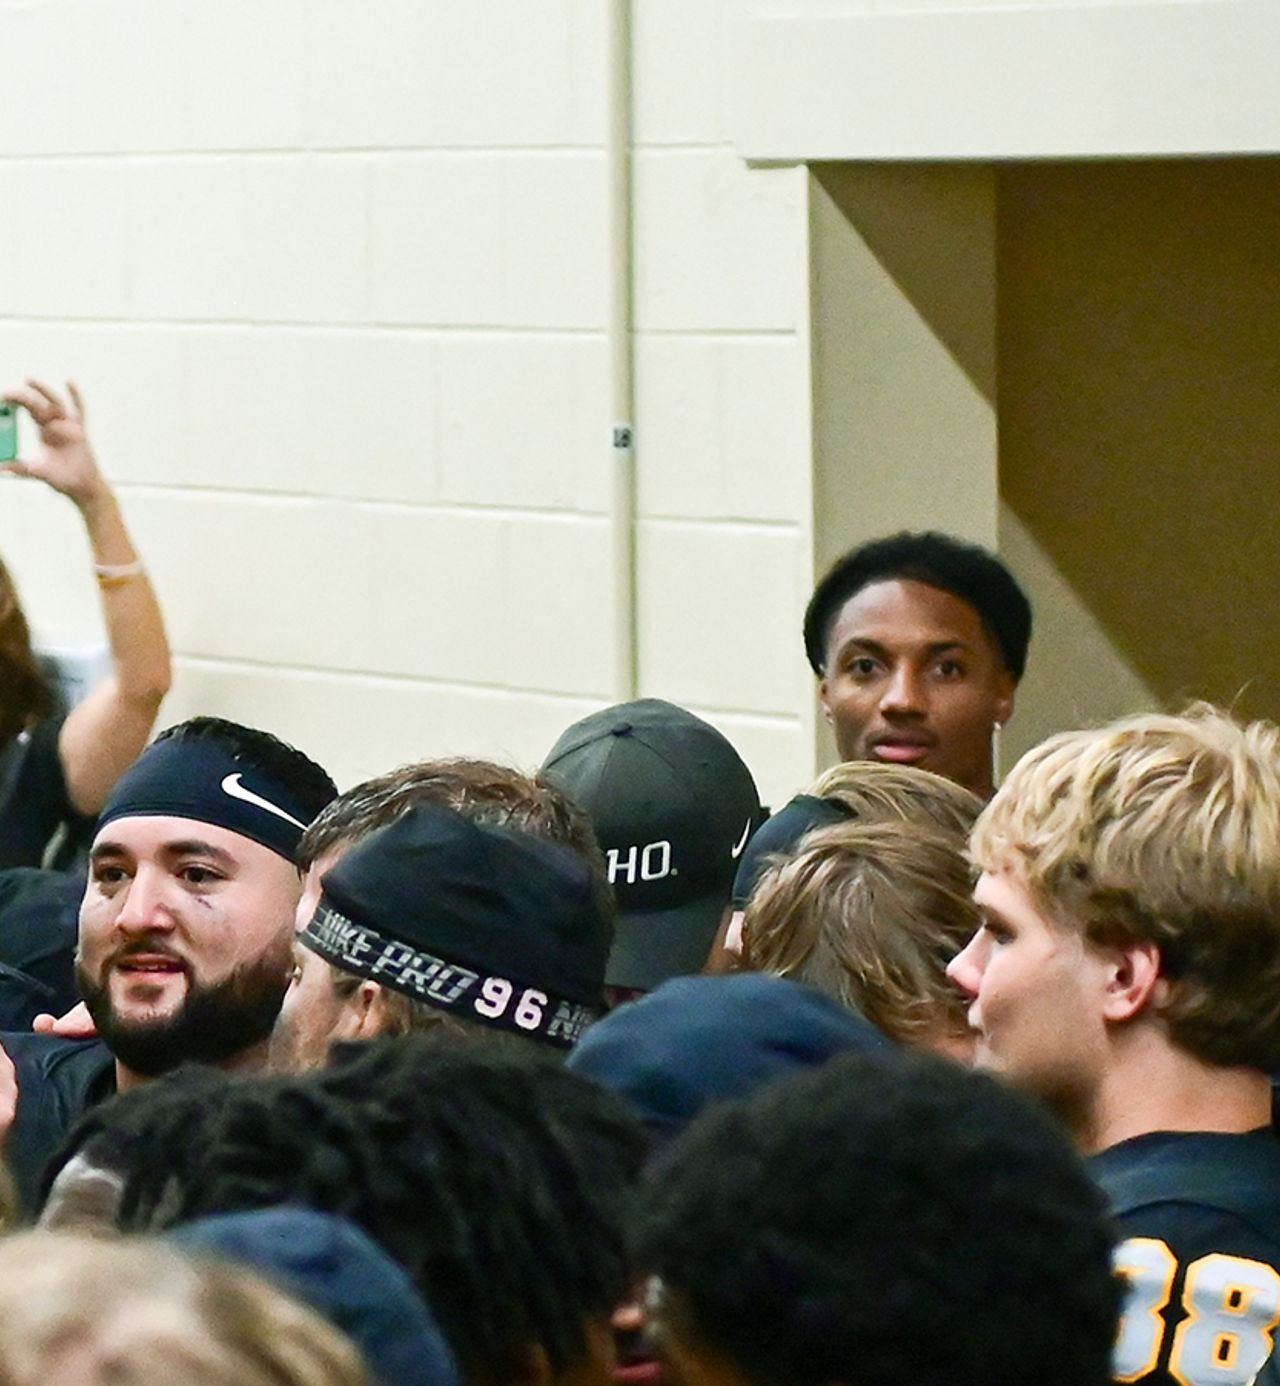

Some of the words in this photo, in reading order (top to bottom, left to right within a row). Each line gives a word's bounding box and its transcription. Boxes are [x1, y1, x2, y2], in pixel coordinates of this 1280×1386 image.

[318, 909, 381, 968] NIKE
[371, 940, 480, 1004] PRO
[474, 976, 549, 1031] 96
